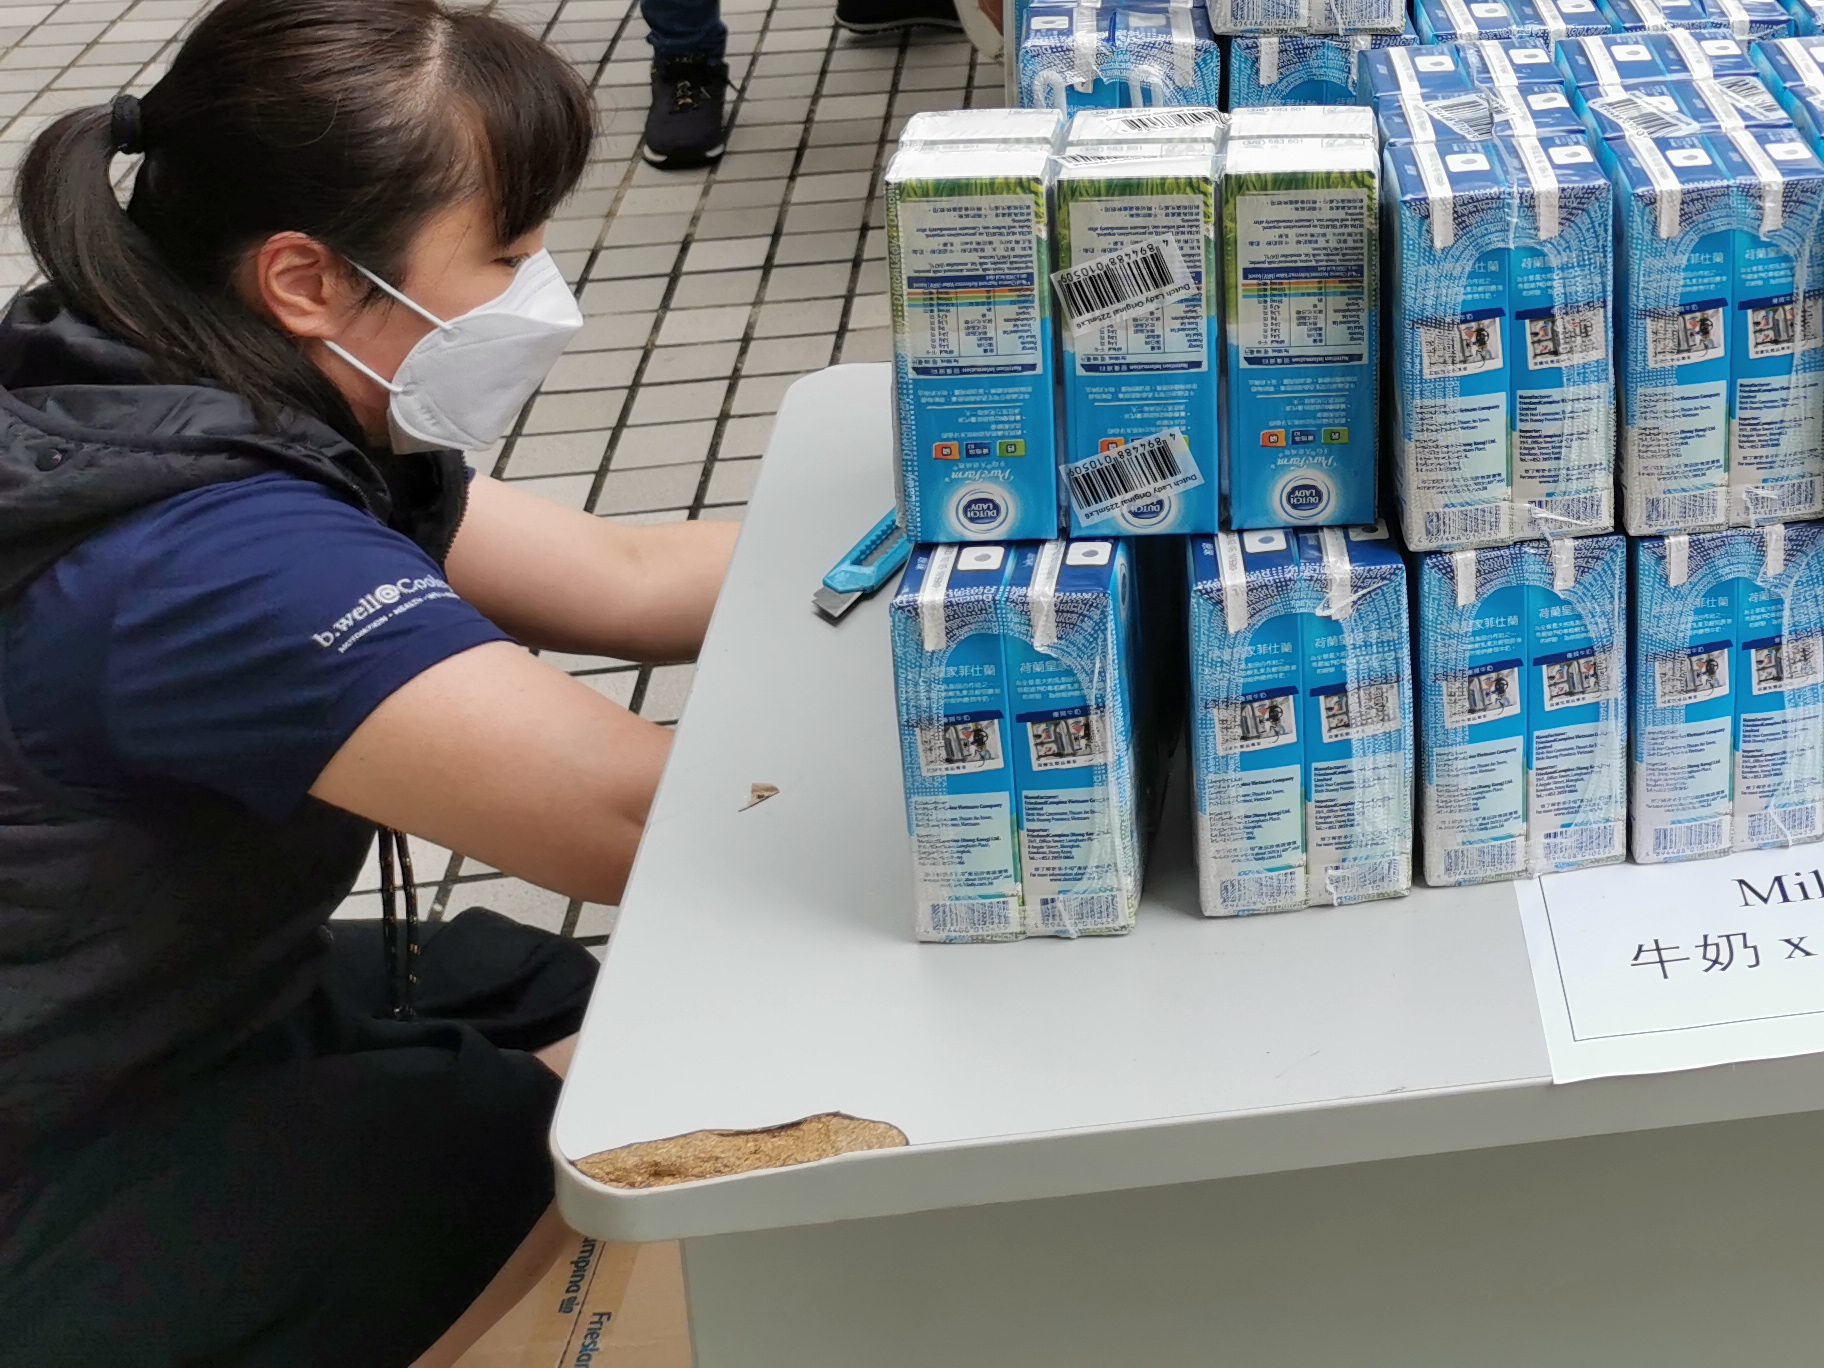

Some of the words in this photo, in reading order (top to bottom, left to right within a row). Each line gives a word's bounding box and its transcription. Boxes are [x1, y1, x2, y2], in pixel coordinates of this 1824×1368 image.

[1108, 243, 1155, 265] 894488
[1060, 262, 1104, 282] 010509
[1166, 283, 1191, 296] Dutch
[1146, 293, 1165, 306] Lady
[1113, 301, 1144, 316] Original
[1076, 312, 1111, 329] 225mLx6
[1170, 433, 1176, 441] 4
[1117, 437, 1162, 460] 894488
[1068, 455, 1112, 477] 010509
[1174, 474, 1197, 487] Dutch
[1153, 483, 1172, 494] Lady
[1295, 489, 1316, 497] LADY
[1120, 491, 1152, 506] Original
[967, 510, 997, 518] DUTCH
[969, 503, 993, 511] LADY
[1084, 502, 1120, 519] 225mLx6
[1630, 932, 1761, 981] 牛奶
[1778, 935, 1818, 959] x
